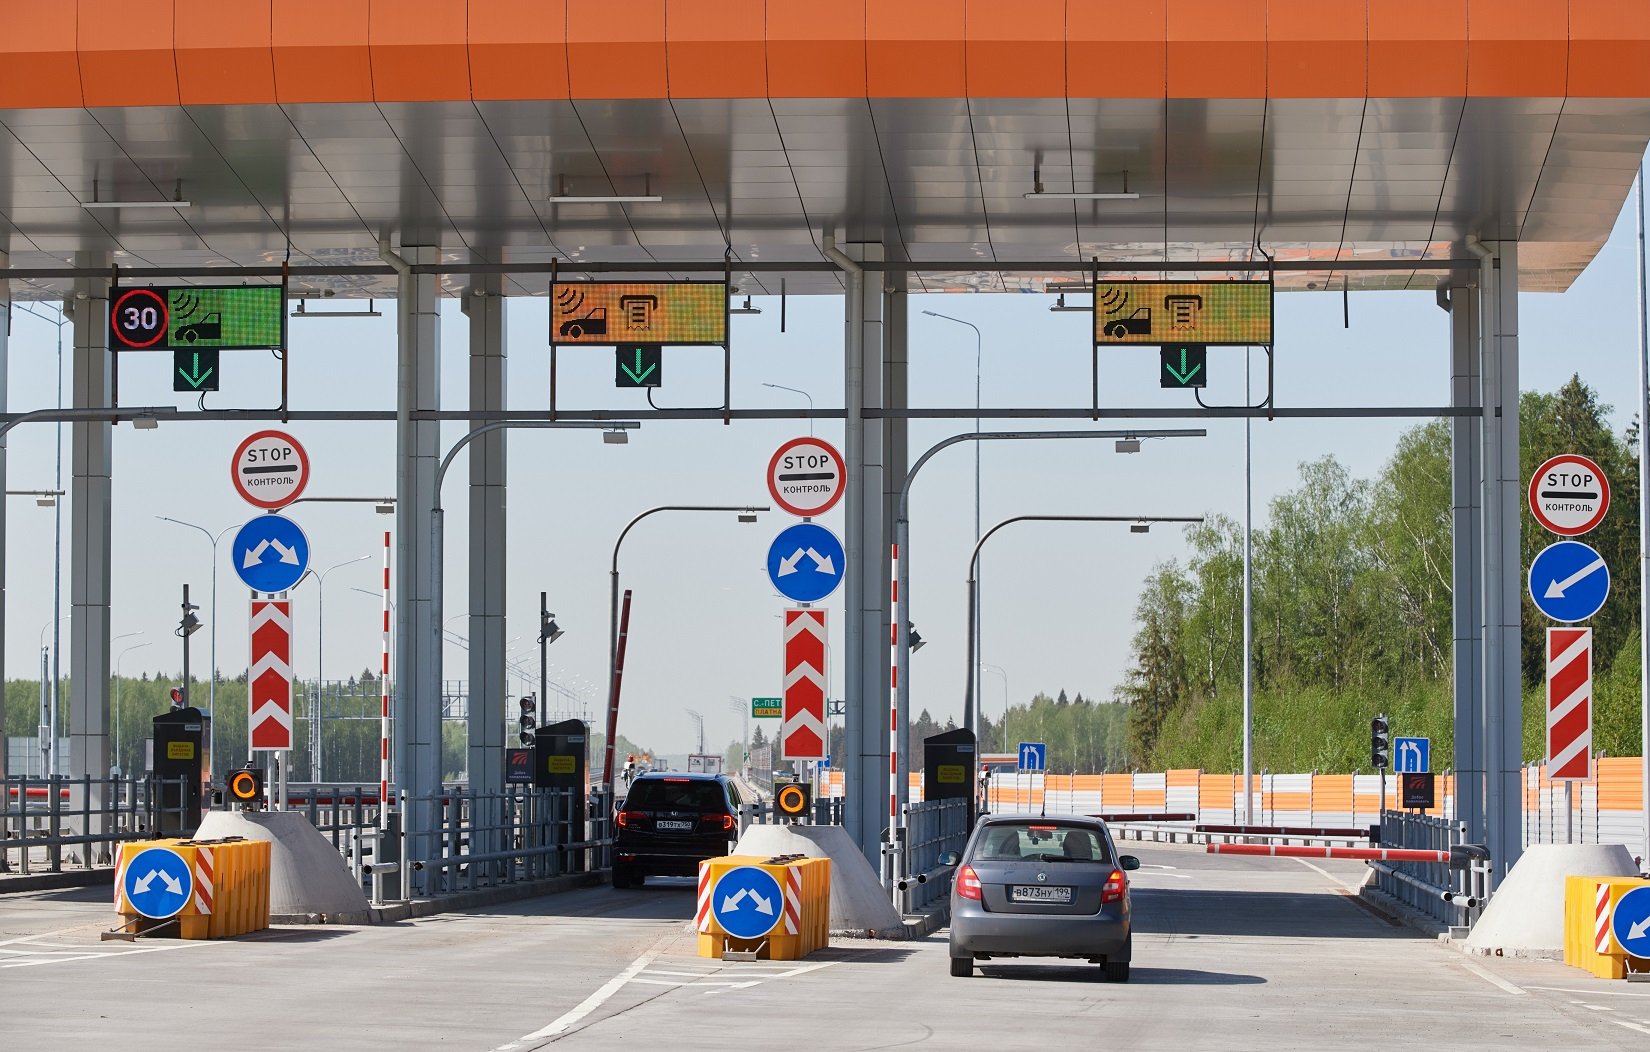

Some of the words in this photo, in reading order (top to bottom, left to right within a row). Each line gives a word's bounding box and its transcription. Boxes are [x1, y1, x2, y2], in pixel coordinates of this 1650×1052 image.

[123, 307, 158, 330] 30
[247, 447, 292, 463] STOP
[783, 455, 829, 469] STOP
[247, 476, 294, 487] КОНТРОЛЬ
[1547, 473, 1593, 487] STOP
[783, 484, 831, 494] КОНТРОЛЬ
[1545, 503, 1593, 512] КОНТРОЛЬ
[753, 699, 782, 707] С.-ПЕТ
[1054, 887, 1069, 896] 199
